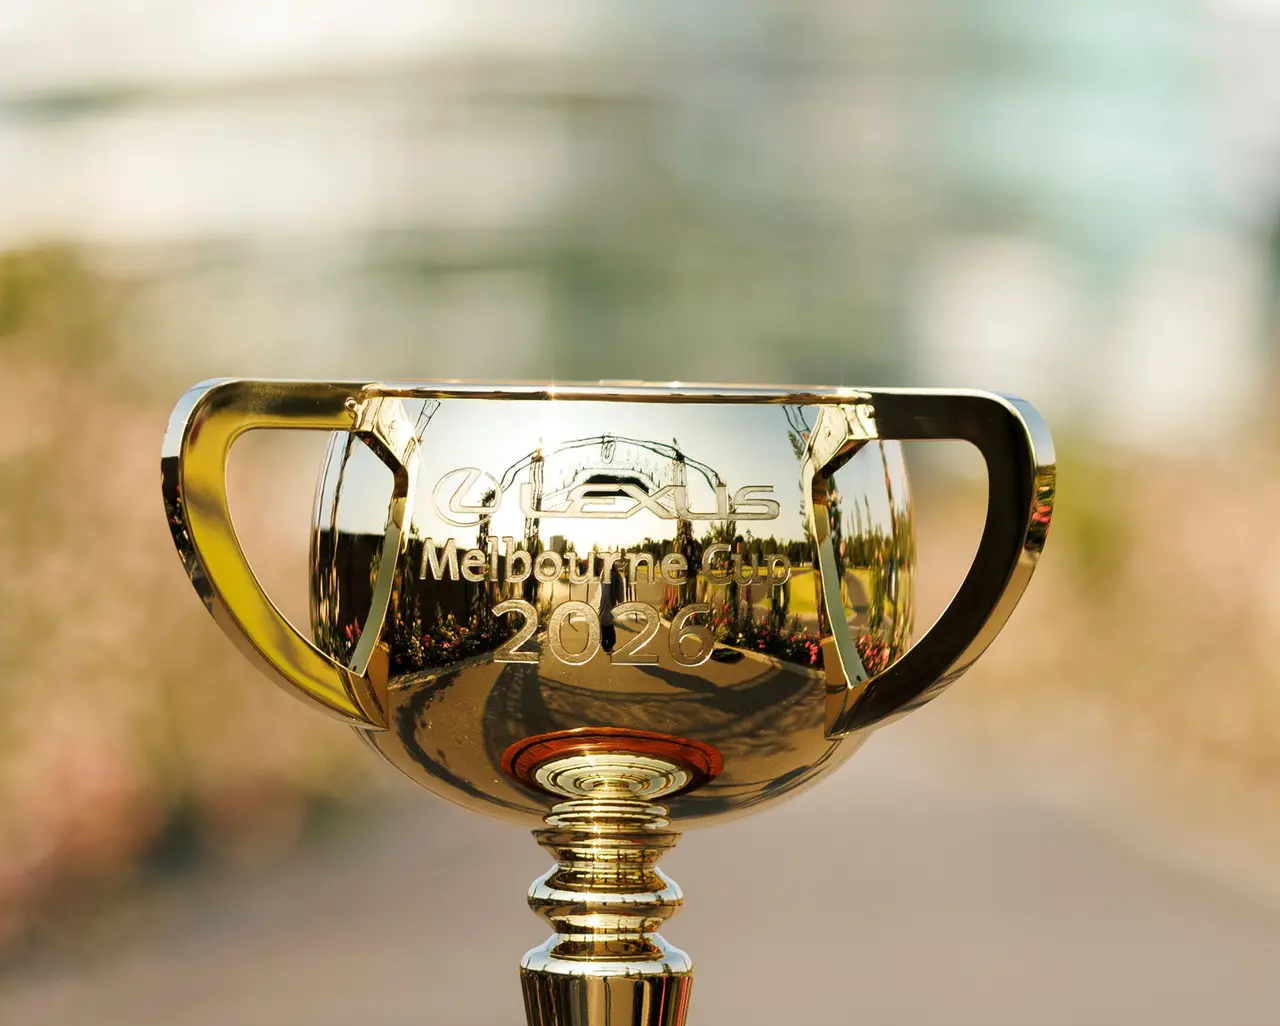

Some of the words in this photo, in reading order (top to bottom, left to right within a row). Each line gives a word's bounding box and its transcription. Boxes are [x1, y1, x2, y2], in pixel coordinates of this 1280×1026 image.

[521, 483, 781, 520] LEXUS
[419, 535, 688, 585] Melbourne
[702, 543, 791, 600] Cup
[492, 599, 715, 667] 2026
